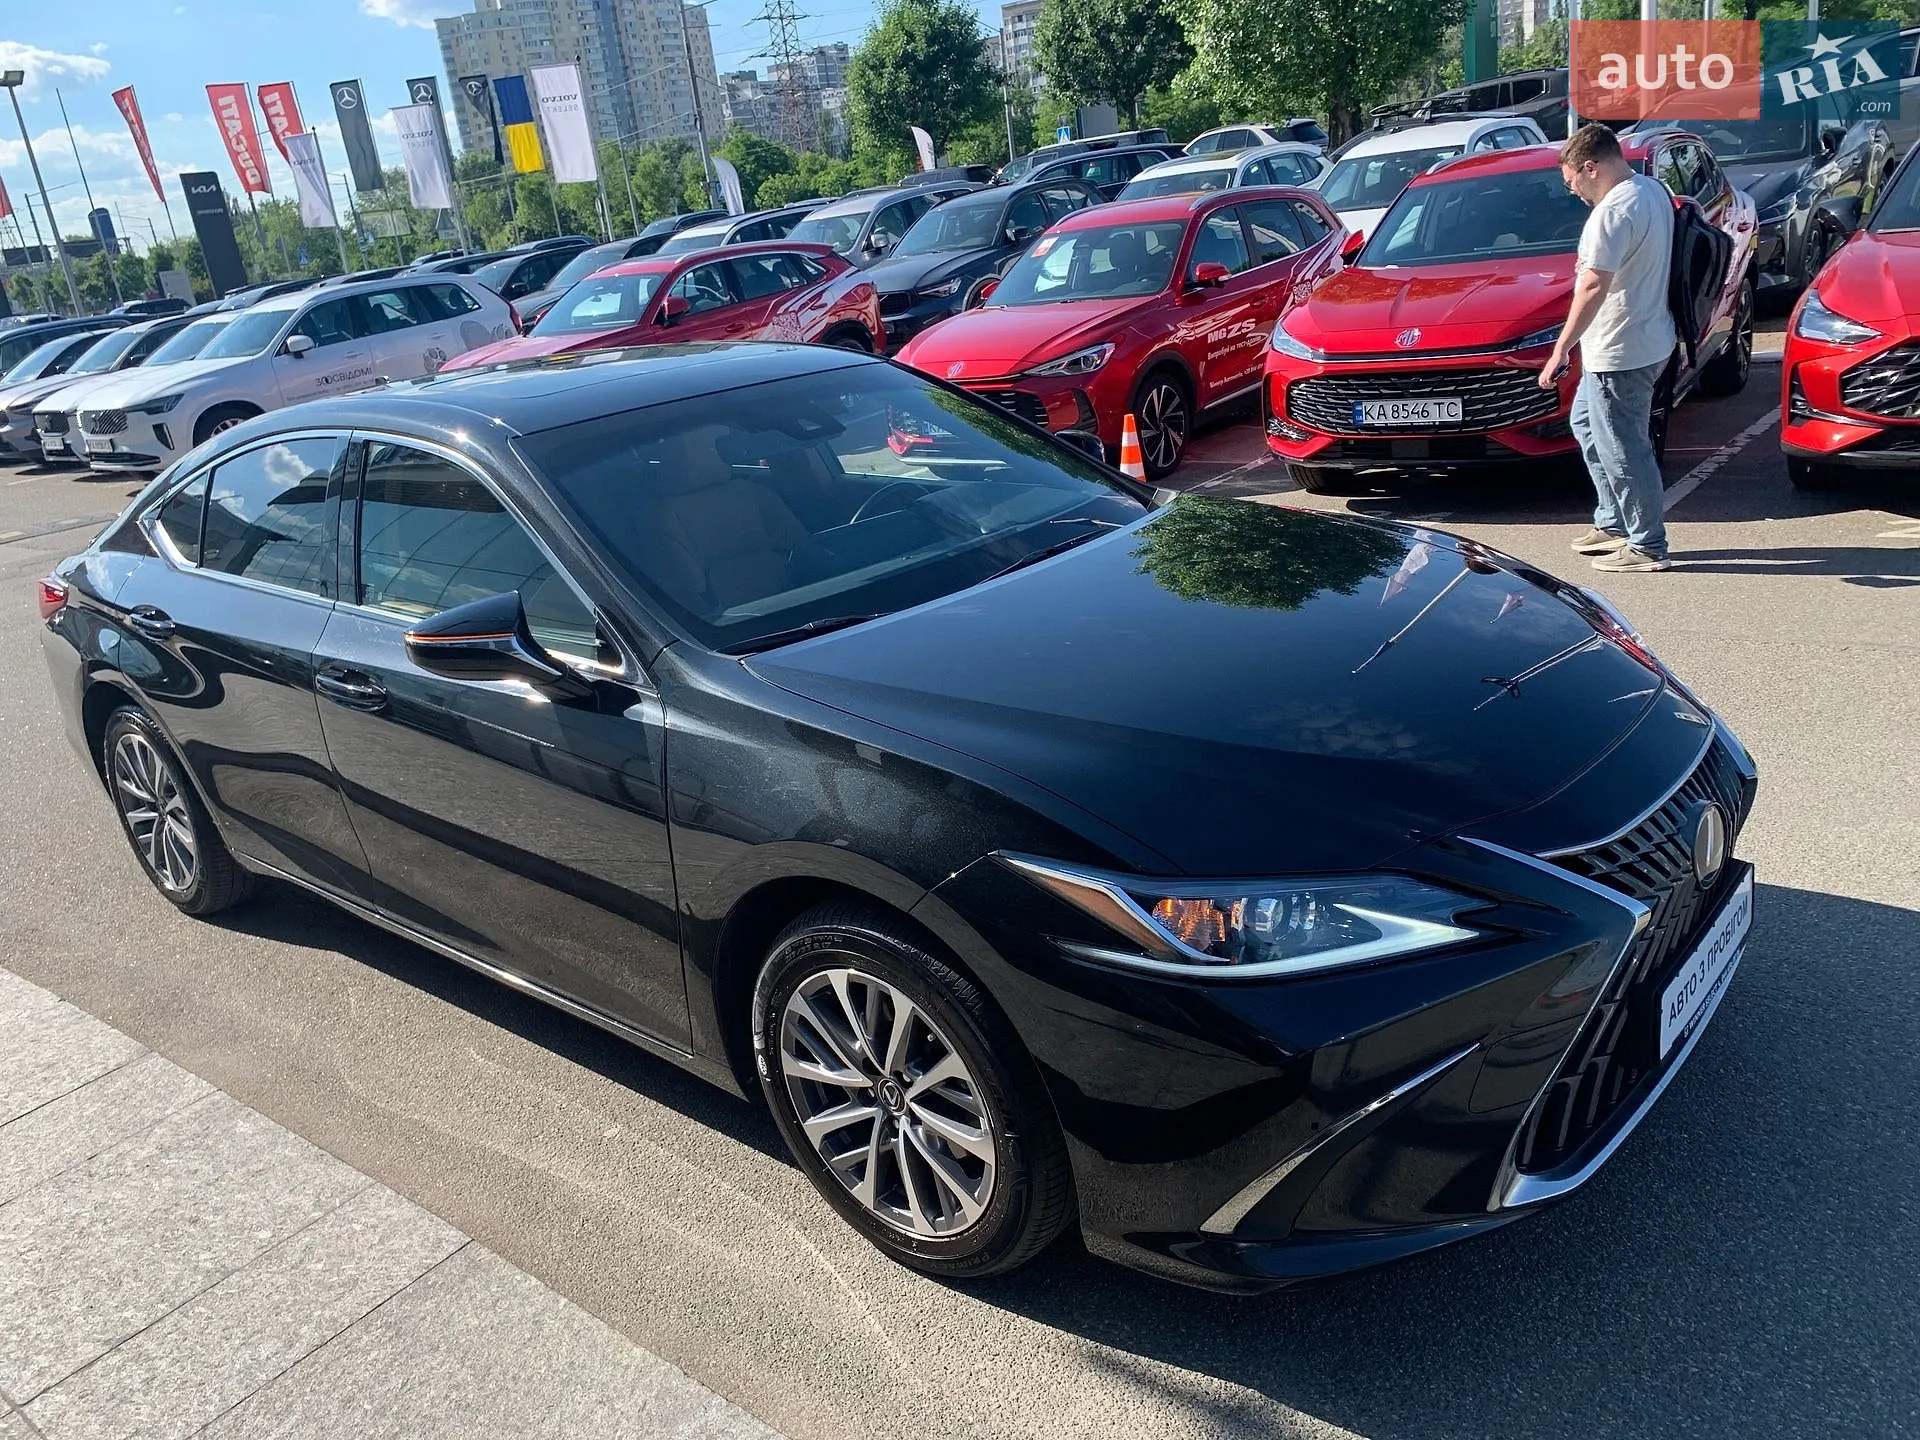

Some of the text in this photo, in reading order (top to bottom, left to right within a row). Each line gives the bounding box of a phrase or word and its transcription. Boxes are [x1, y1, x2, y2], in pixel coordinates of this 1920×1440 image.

[191, 184, 217, 194] KIA
[1208, 318, 1256, 343] MG ZS
[1363, 401, 1458, 421] KA 8546 TC
[1668, 971, 1698, 1028] АВТО
[1706, 895, 1749, 972] ПРОБІГОМ
